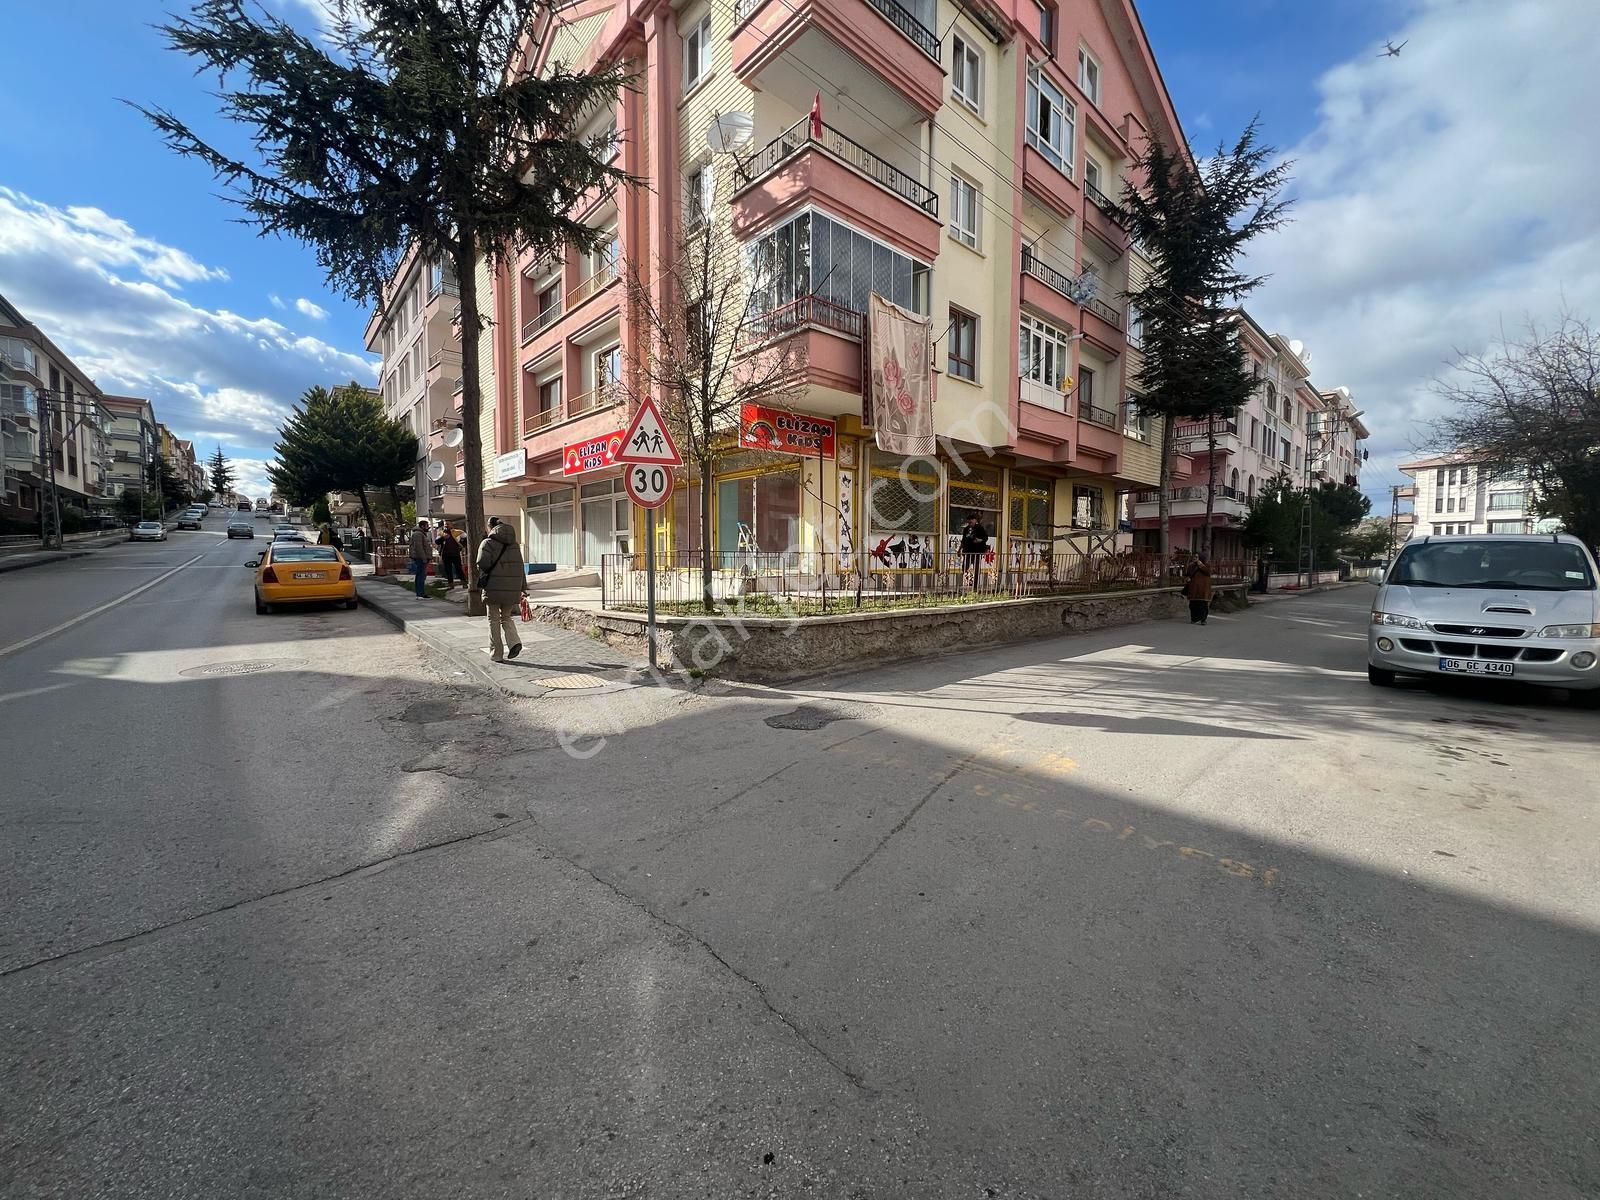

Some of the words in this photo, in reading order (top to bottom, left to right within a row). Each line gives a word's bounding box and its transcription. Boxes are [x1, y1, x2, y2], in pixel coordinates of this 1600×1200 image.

[635, 469, 664, 493] 30
[1447, 660, 1459, 668] 06
[1485, 663, 1511, 672] 4340
